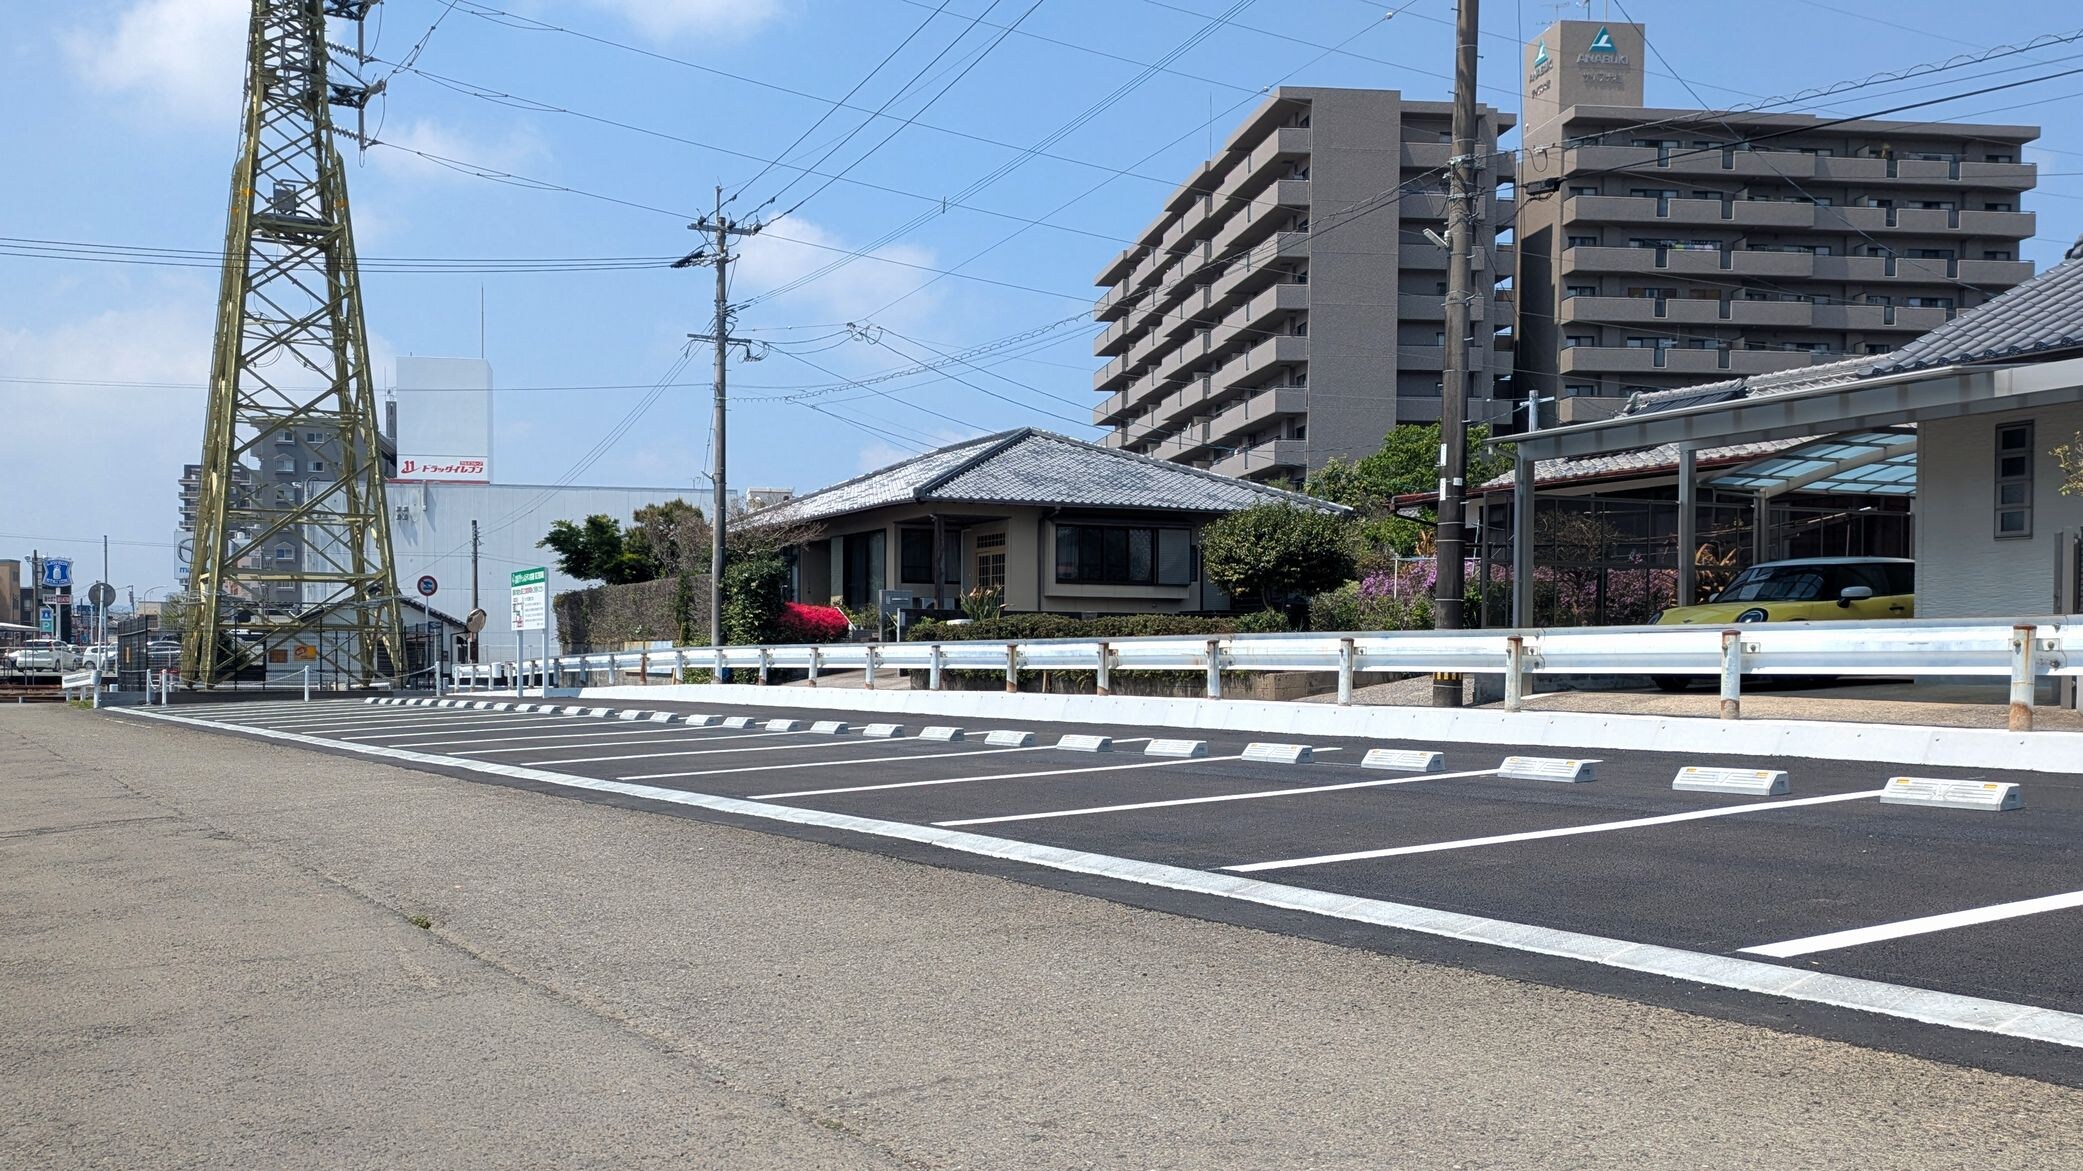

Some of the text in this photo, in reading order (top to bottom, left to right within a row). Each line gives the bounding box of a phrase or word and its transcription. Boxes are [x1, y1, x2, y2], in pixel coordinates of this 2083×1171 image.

[1576, 54, 1628, 65] ANABUKI
[422, 465, 484, 473] ドラッグイレブン
